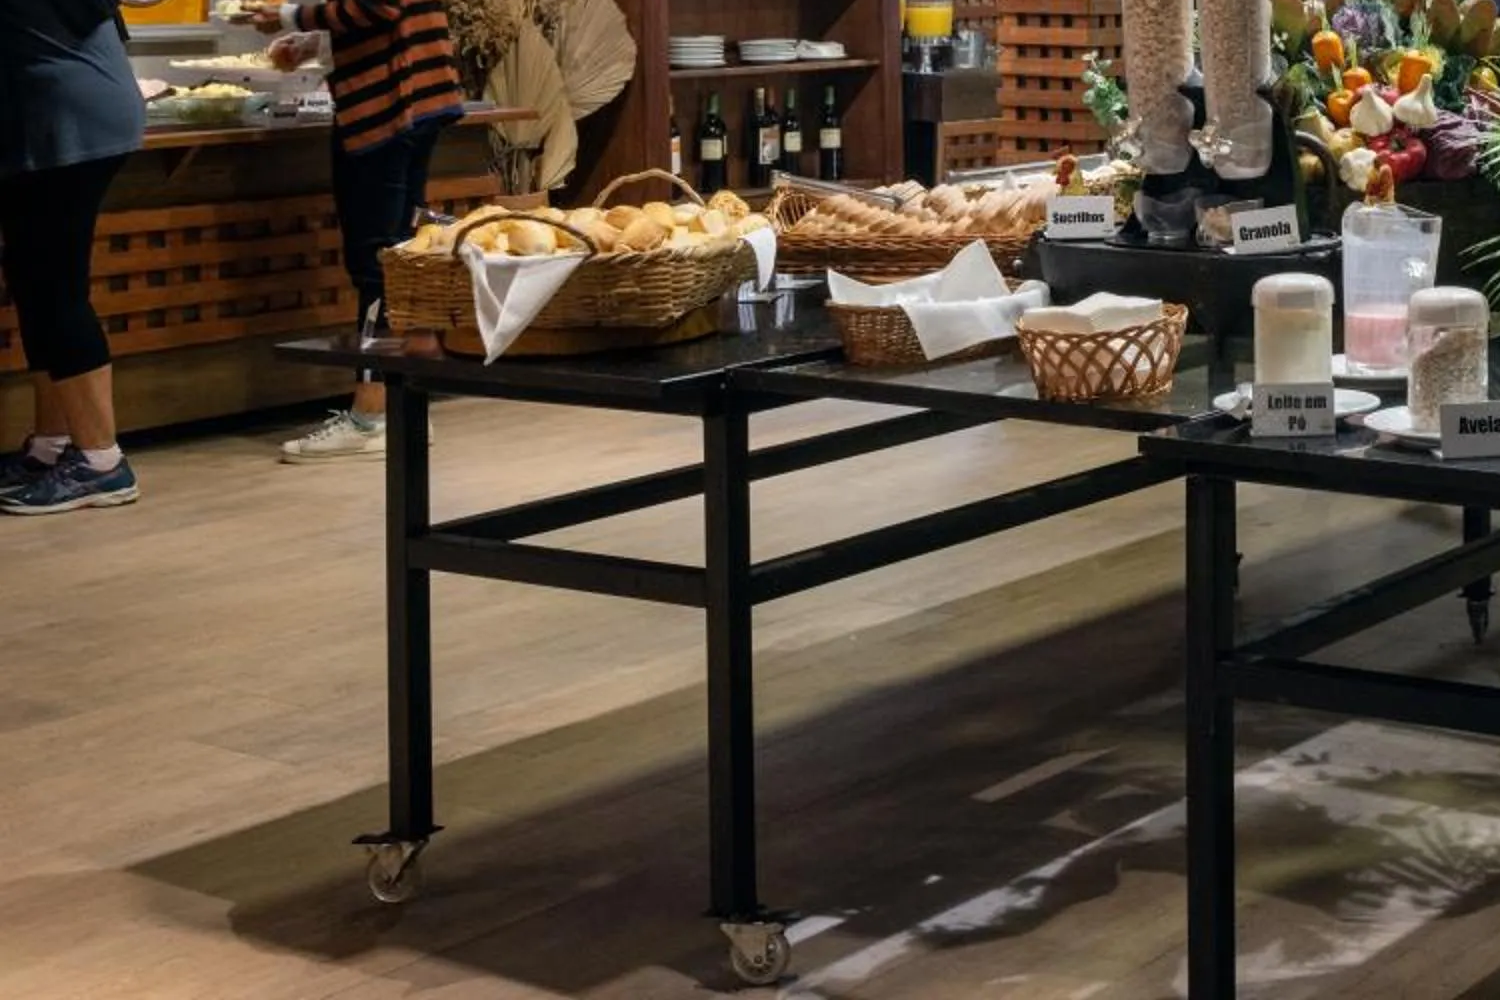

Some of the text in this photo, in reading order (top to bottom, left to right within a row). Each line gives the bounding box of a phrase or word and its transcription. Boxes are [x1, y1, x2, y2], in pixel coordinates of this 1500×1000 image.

[1052, 211, 1105, 225] Sucrilhos
[1240, 221, 1292, 241] Granola
[1267, 393, 1327, 409] Leite em
[1288, 413, 1307, 431] Pó
